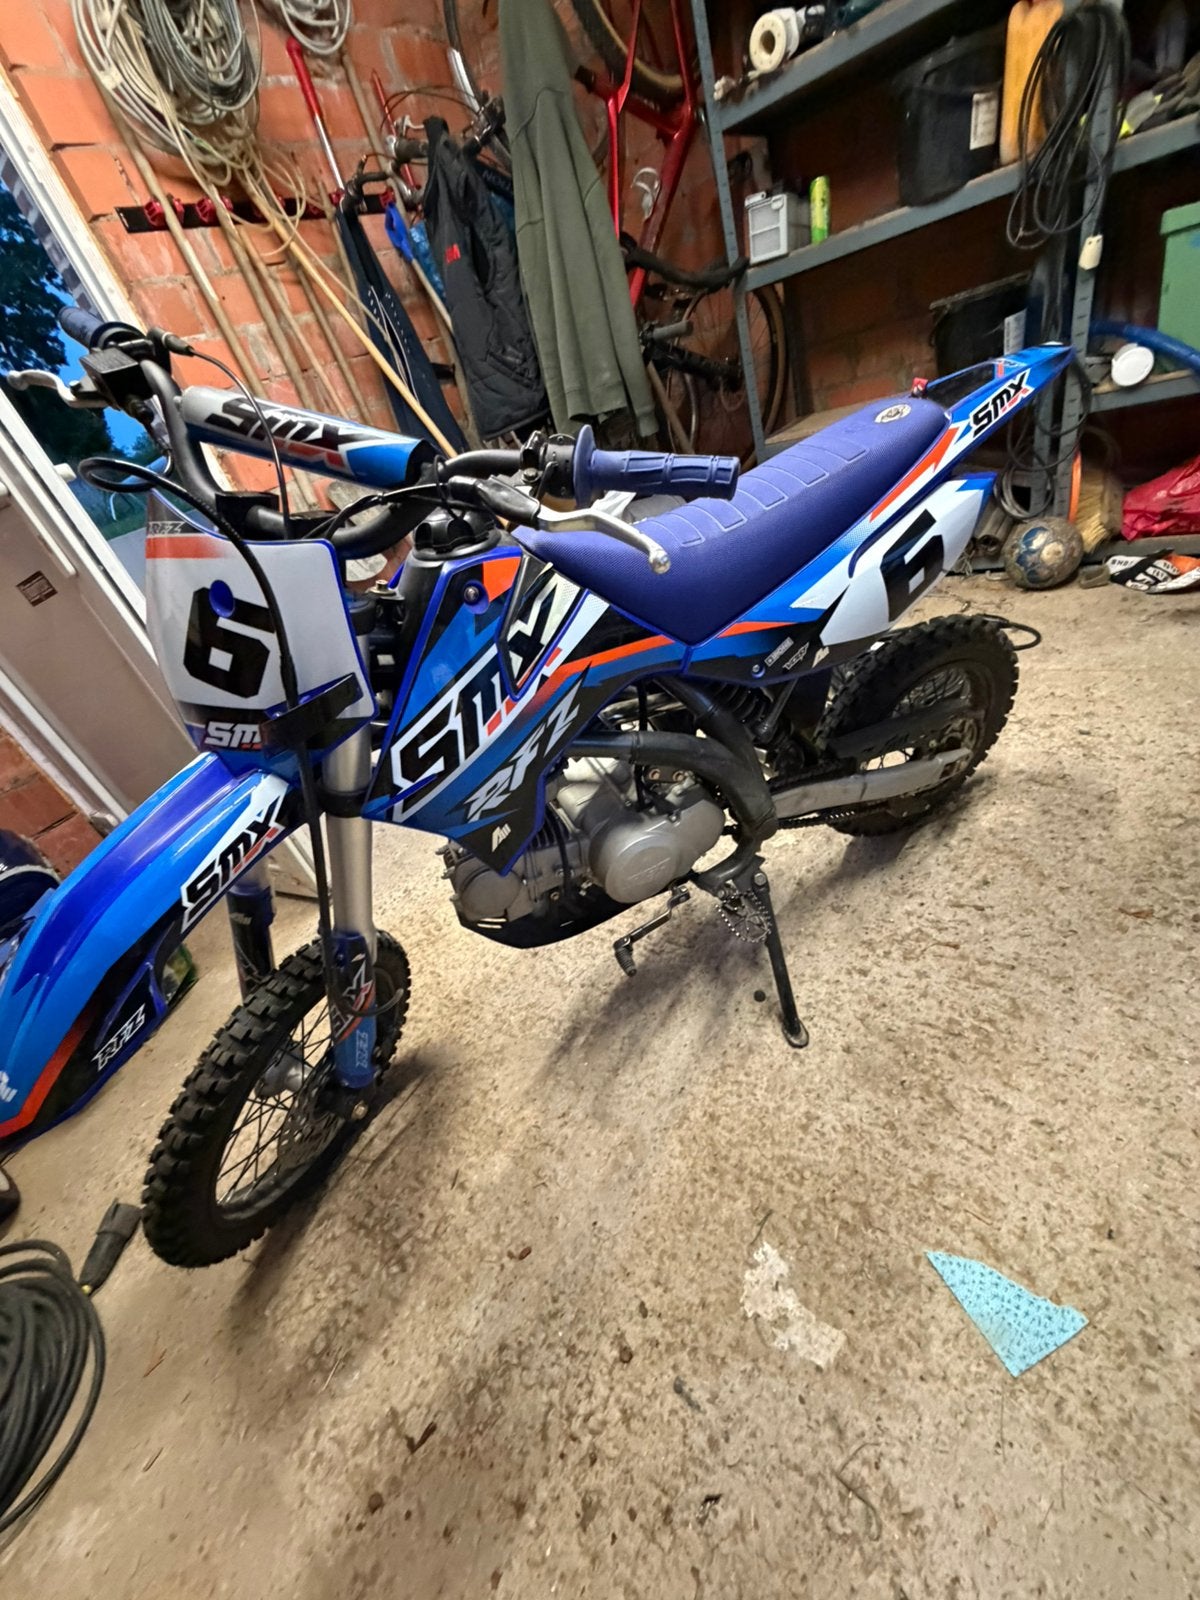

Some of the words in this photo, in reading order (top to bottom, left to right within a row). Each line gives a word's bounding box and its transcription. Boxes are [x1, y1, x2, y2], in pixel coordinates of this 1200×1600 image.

[204, 397, 378, 469] SMX
[974, 371, 1031, 437] SMX
[183, 586, 276, 698] 6
[204, 721, 263, 748] SM
[400, 573, 564, 815] SMX
[463, 677, 584, 823] RFZ
[186, 795, 281, 922] SMX
[91, 1003, 146, 1072] RFZ
